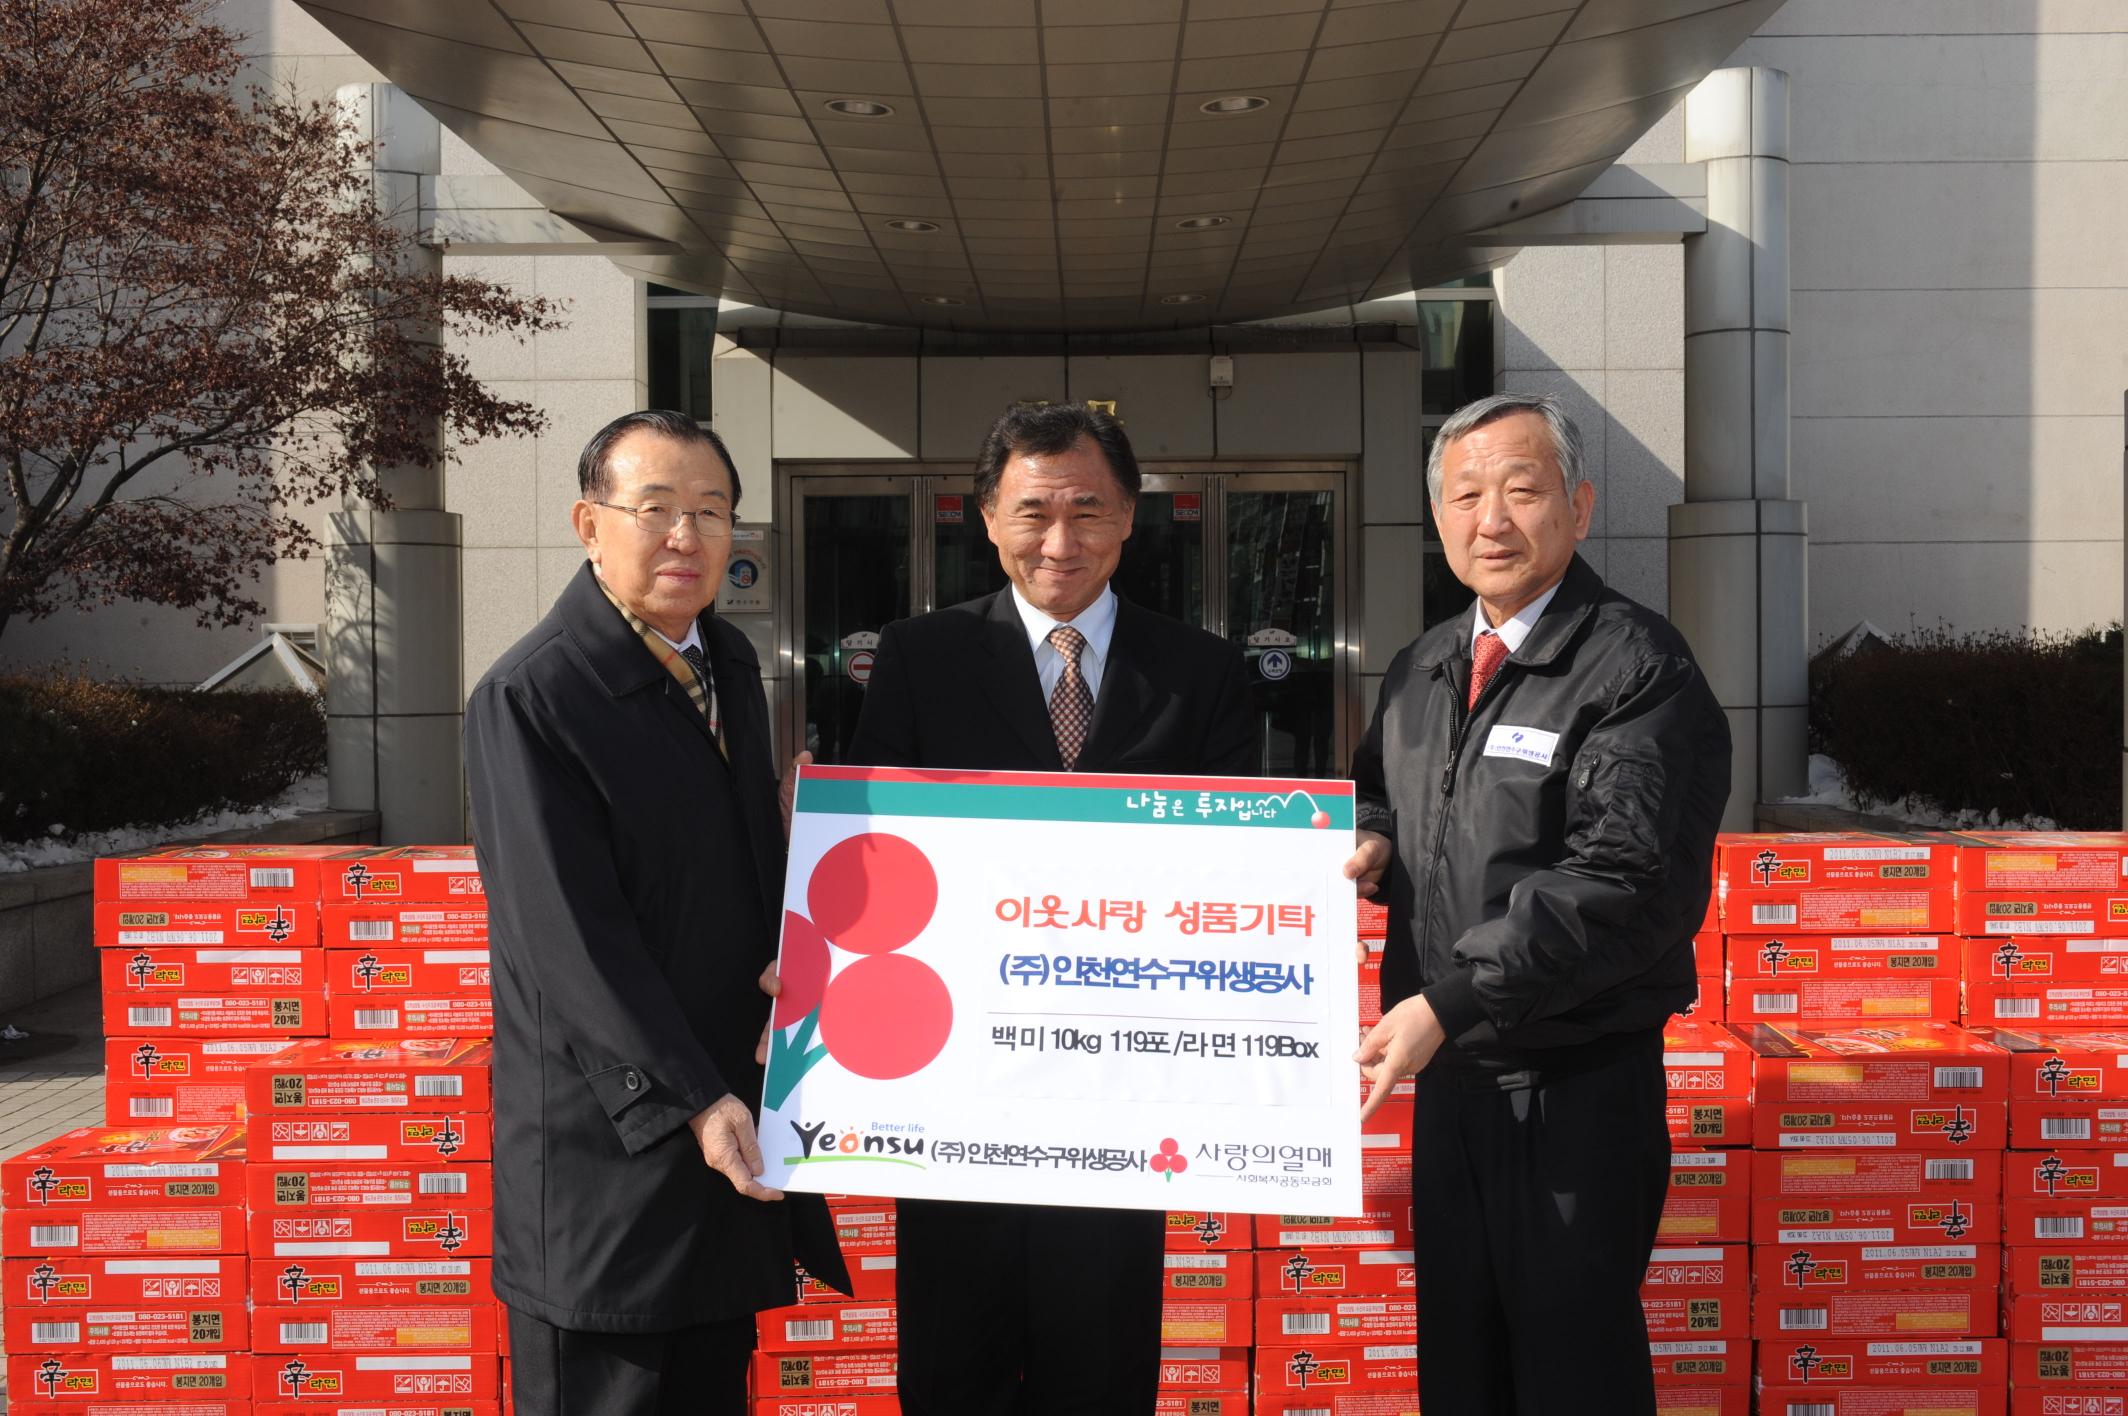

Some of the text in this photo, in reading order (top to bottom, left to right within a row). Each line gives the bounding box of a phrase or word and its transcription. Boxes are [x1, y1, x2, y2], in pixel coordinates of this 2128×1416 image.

[1126, 790, 1278, 821] 나눔은 투자입니다
[347, 862, 397, 899] 辛 라면
[1755, 848, 1806, 887] 辛 라면
[1882, 867, 1926, 878] 봉지면 20개입
[264, 904, 290, 942] 辛
[995, 894, 1316, 937] 이웃사랑 성품기탁
[131, 953, 181, 990] 辛 라면
[357, 954, 407, 992] 辛 라면
[999, 953, 1314, 995] (주)인천연수구위생공사
[1762, 939, 1814, 977] 辛 라면
[1890, 957, 1935, 967] 봉지면 20개입
[1996, 942, 2048, 980] 辛 라면
[273, 1001, 300, 1013] 봉지면
[273, 1014, 301, 1026] 20개입
[992, 1025, 1045, 1052] 백미
[1050, 1027, 1101, 1055] 10kg
[1241, 1033, 1320, 1059] 119Box
[136, 1042, 186, 1080] 辛 라면
[2041, 1056, 2097, 1097] 辛 라면
[871, 1121, 926, 1134] Better life
[1693, 1108, 1723, 1120] 봉지면
[1693, 1123, 1723, 1134] 20개입
[1942, 1104, 1972, 1145] 辛
[431, 1116, 461, 1156] 辛
[790, 1119, 924, 1160] Yeonsu
[930, 1139, 1148, 1173] (주)인천연수구위생공사
[1195, 1142, 1333, 1173] 사랑의열매
[31, 1166, 86, 1206] 辛 라면
[168, 1184, 215, 1196] 봉지면 20개입
[1236, 1173, 1333, 1188] 사회복지공동모금회
[1675, 1173, 1722, 1185] 봉지면 20개입
[2039, 1156, 2094, 1197] 辛 라면
[434, 1211, 463, 1251] 辛
[1193, 1212, 1222, 1245] 辛
[1939, 1199, 1968, 1240] 辛
[32, 1263, 86, 1304] 辛 라면
[282, 1263, 337, 1304] 辛 라면
[1175, 1275, 1222, 1287] 봉지면 20개입
[1286, 1254, 1340, 1294] 辛 라면
[1788, 1250, 1842, 1290] 辛 라면
[1924, 1266, 1972, 1278] 봉지면 20개입
[419, 1282, 467, 1294] 봉지면 20개입
[138, 1312, 184, 1321] 080-023-5181
[192, 1313, 220, 1326] 봉지면
[1690, 1301, 1719, 1314] 봉지면
[1690, 1317, 1719, 1328] 20개입
[192, 1328, 221, 1340] 20개입
[40, 1359, 94, 1399] 辛 라면
[175, 1375, 223, 1387] 봉지면 20개입
[283, 1359, 338, 1400] 辛 라면
[1290, 1351, 1345, 1391] 辛 라면
[1676, 1361, 1722, 1373] 봉지면 20개입
[1792, 1344, 1848, 1384] 辛 라면
[1930, 1361, 1978, 1373] 봉지면 20개입
[1191, 1401, 1219, 1413] 봉지면
